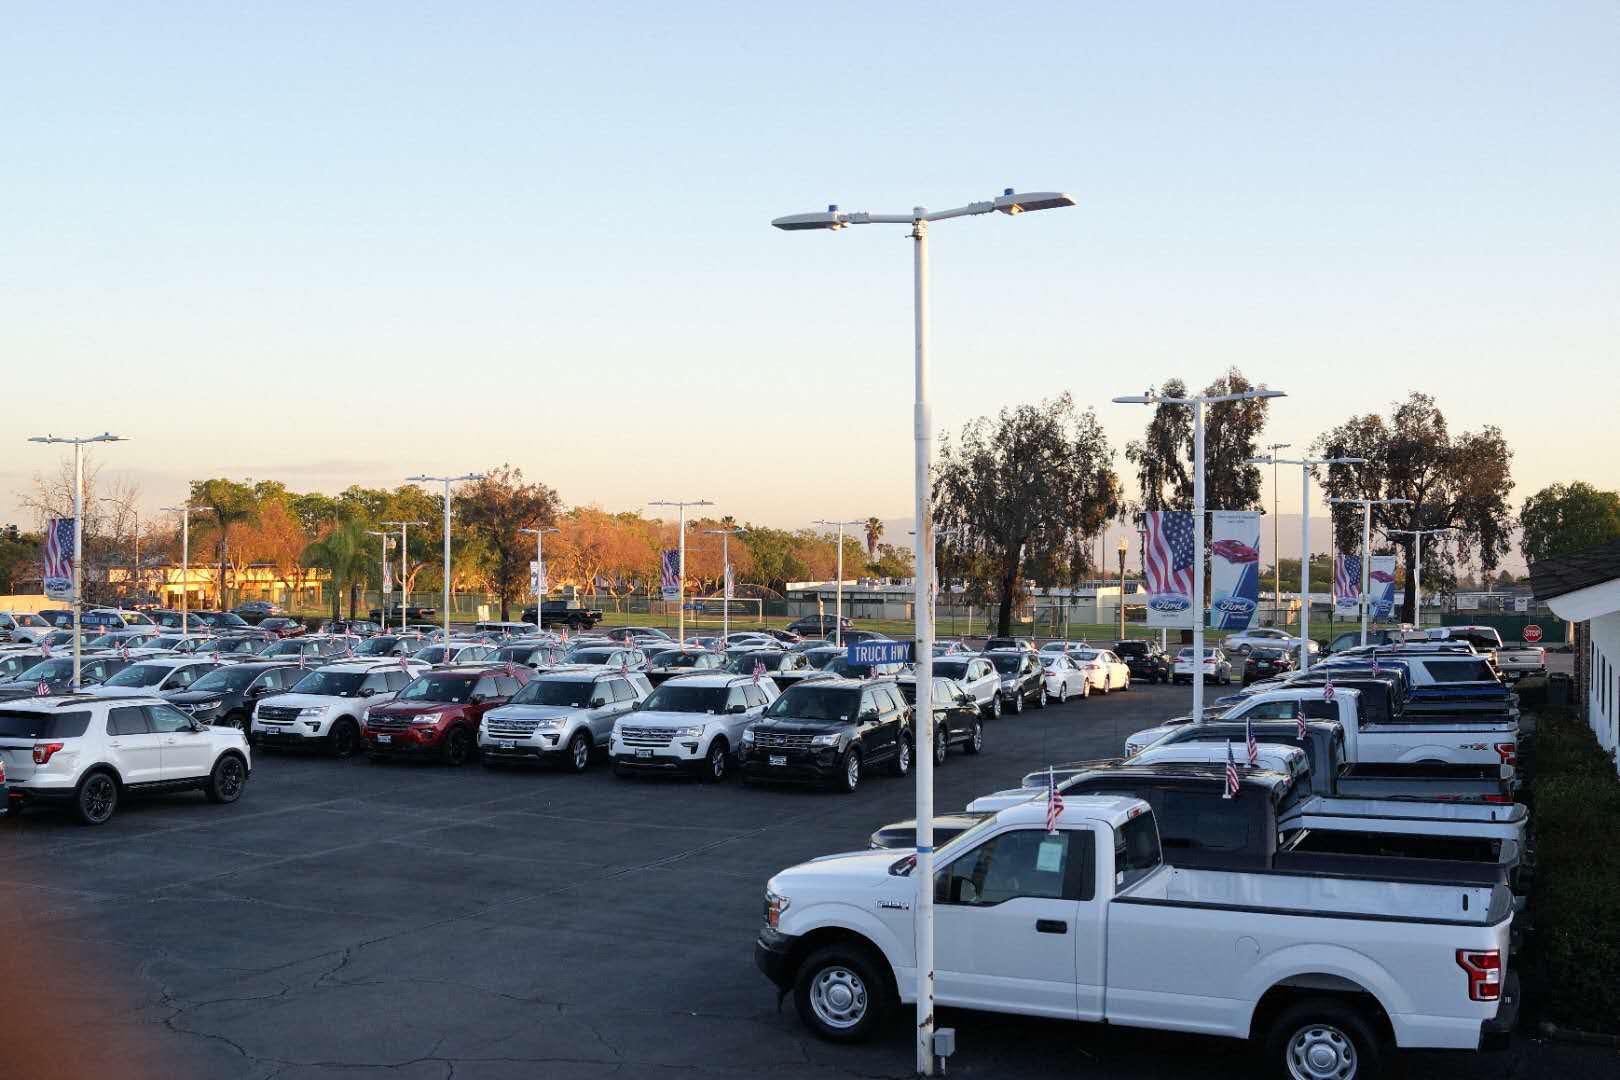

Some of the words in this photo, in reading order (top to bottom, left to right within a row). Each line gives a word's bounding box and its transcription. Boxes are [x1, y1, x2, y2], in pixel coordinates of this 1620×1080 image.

[1156, 599, 1184, 610] Ford
[1220, 600, 1249, 611] Ford
[1525, 630, 1541, 638] STOP
[855, 645, 887, 662] TRUCK
[891, 643, 910, 660] HWY
